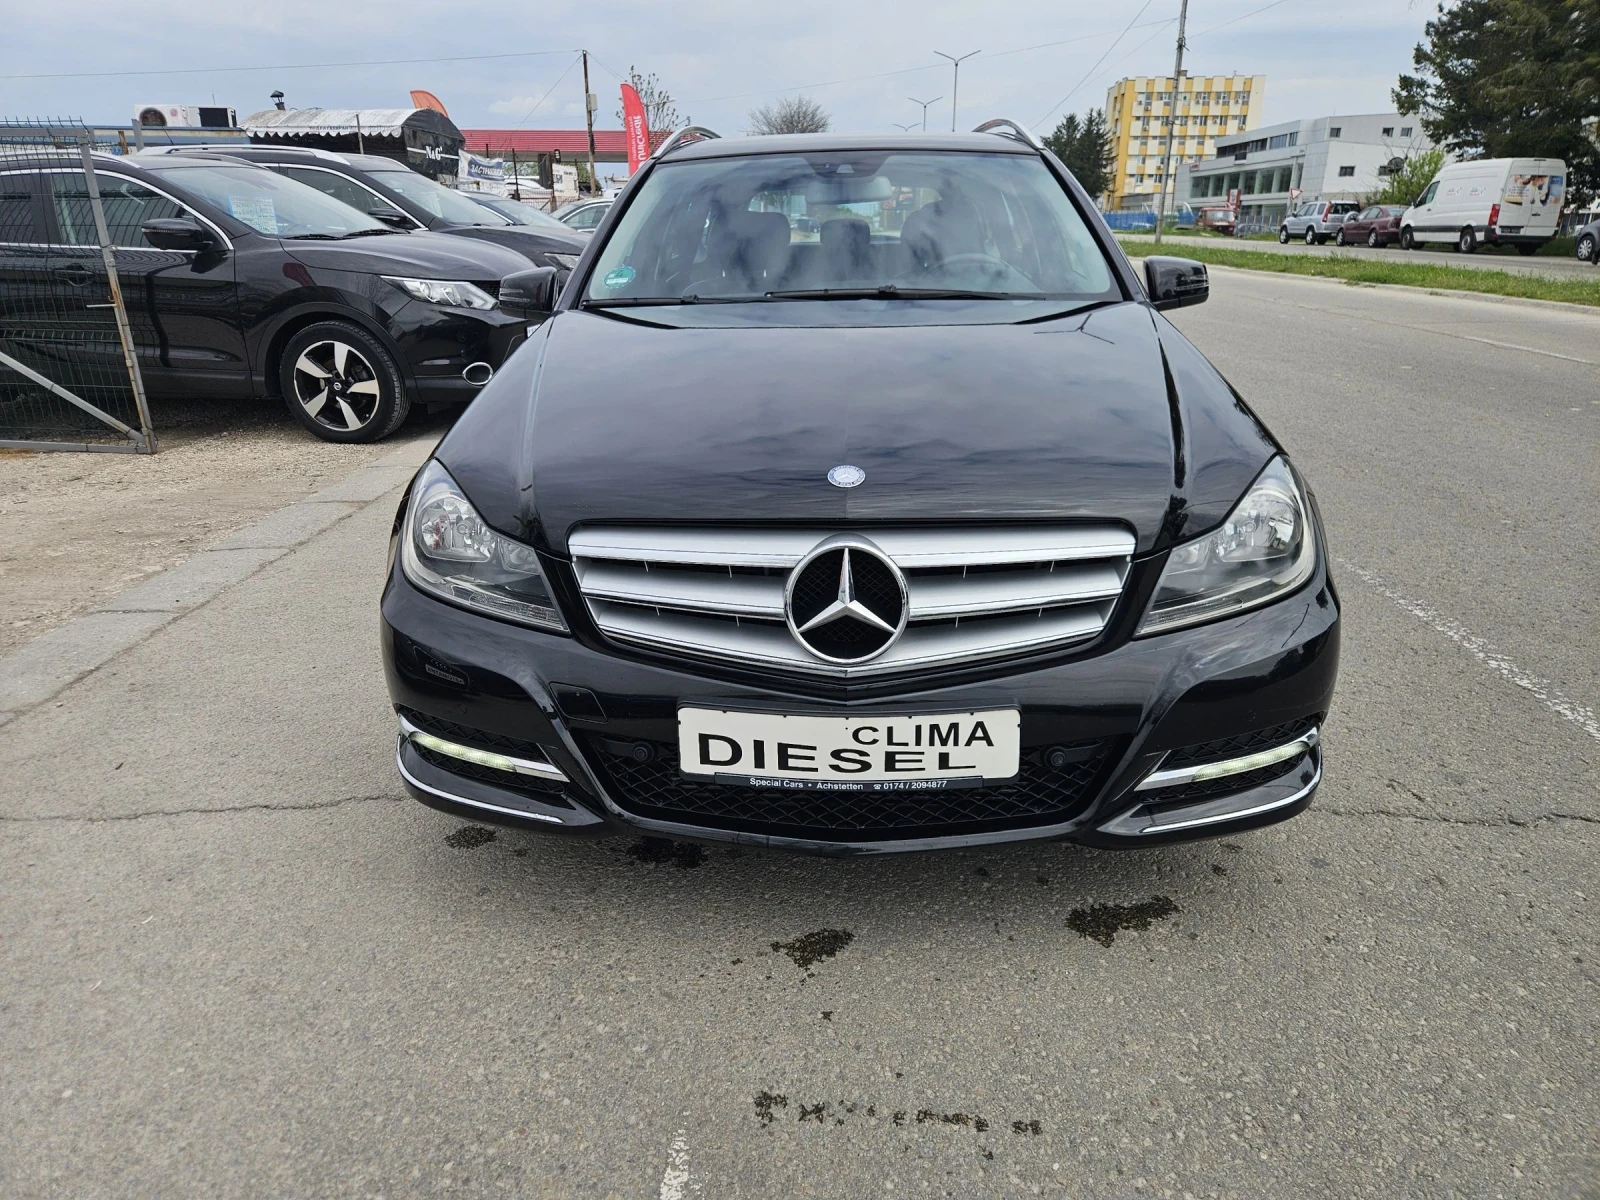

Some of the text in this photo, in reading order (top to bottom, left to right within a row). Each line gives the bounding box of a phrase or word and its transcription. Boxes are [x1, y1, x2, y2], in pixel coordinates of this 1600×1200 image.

[851, 720, 995, 747] CLIMA
[698, 732, 977, 774] DIESEL
[749, 777, 781, 787] Special
[783, 780, 804, 788] Cars
[816, 782, 864, 790] Achstetten
[883, 782, 905, 790] 0174
[911, 780, 948, 789] 2094877
